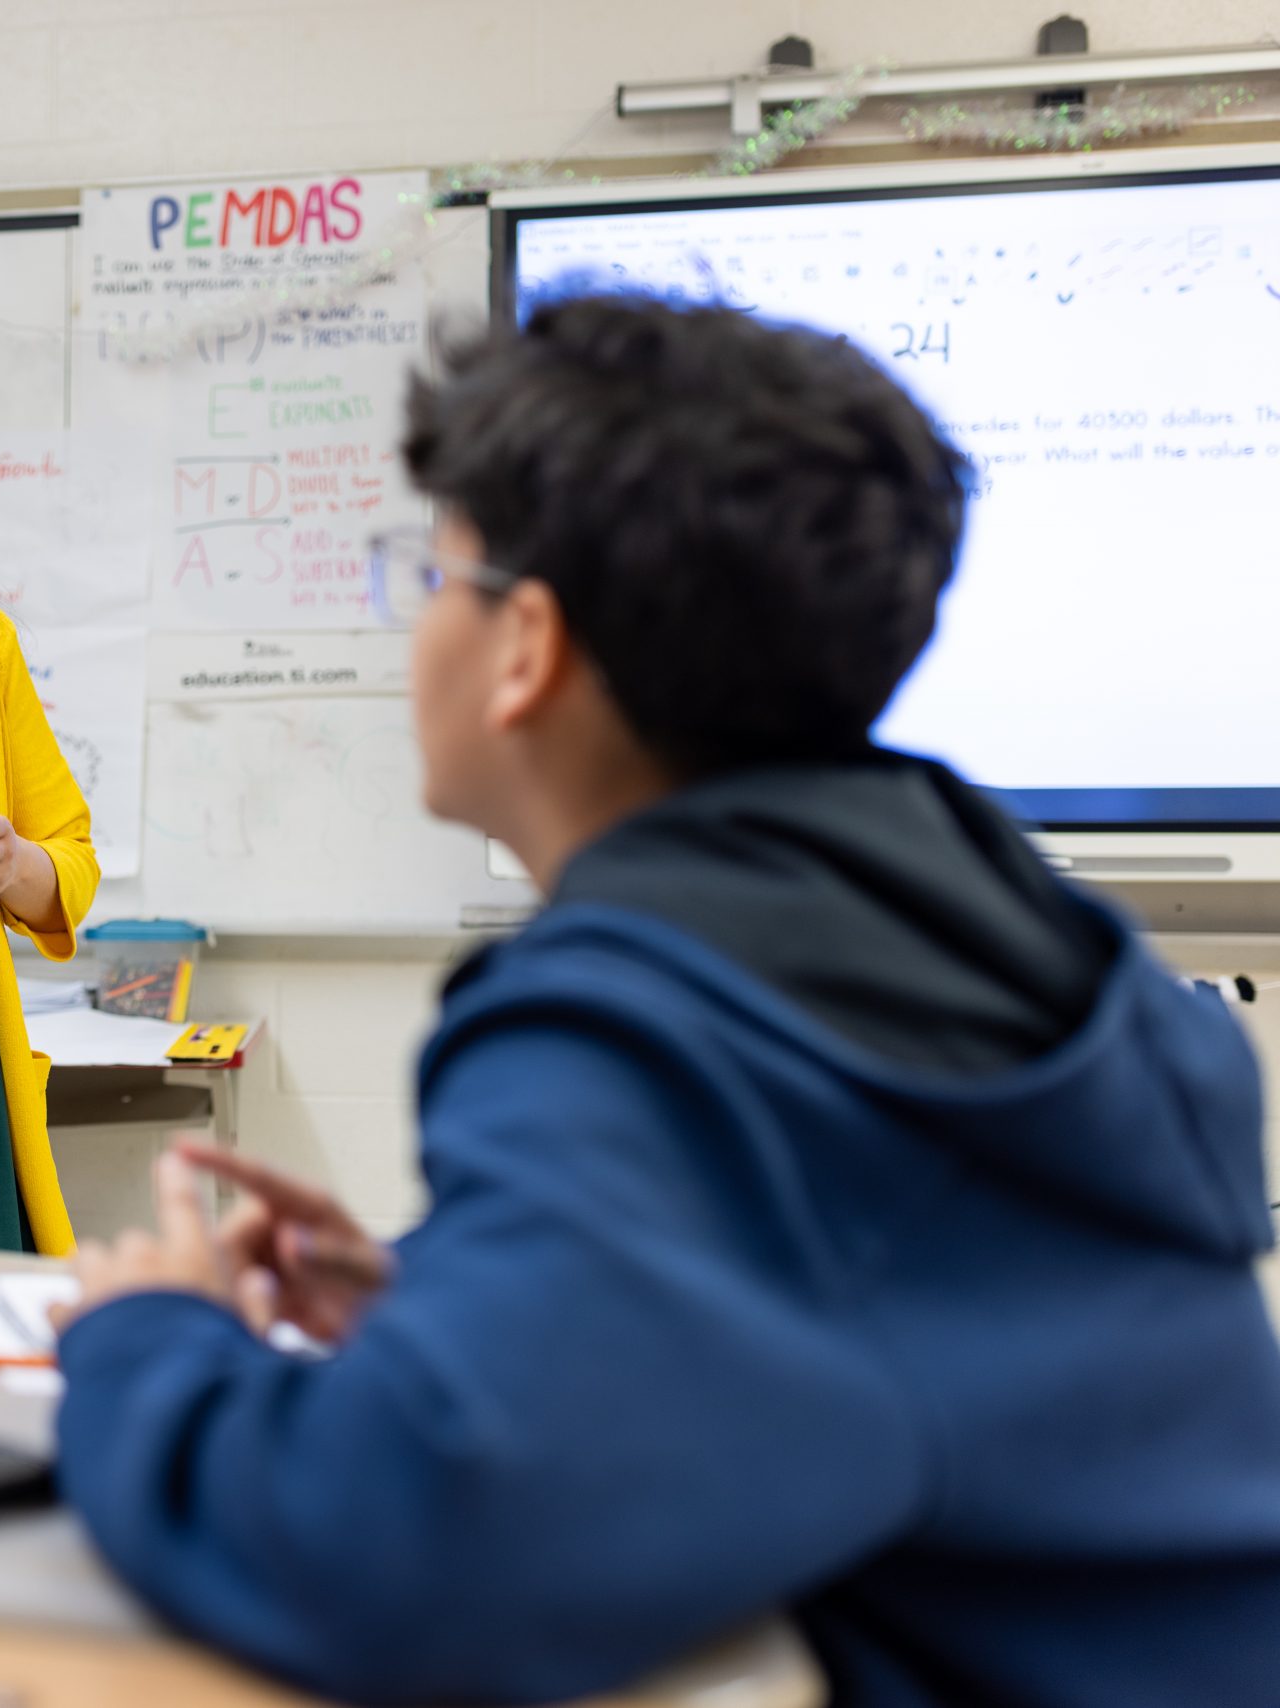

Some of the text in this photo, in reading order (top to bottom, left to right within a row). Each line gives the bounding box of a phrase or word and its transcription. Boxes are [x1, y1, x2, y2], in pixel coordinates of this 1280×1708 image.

[149, 177, 363, 250] PEMDAS
[890, 321, 950, 364] 24
[180, 667, 358, 689] education.ti.com
